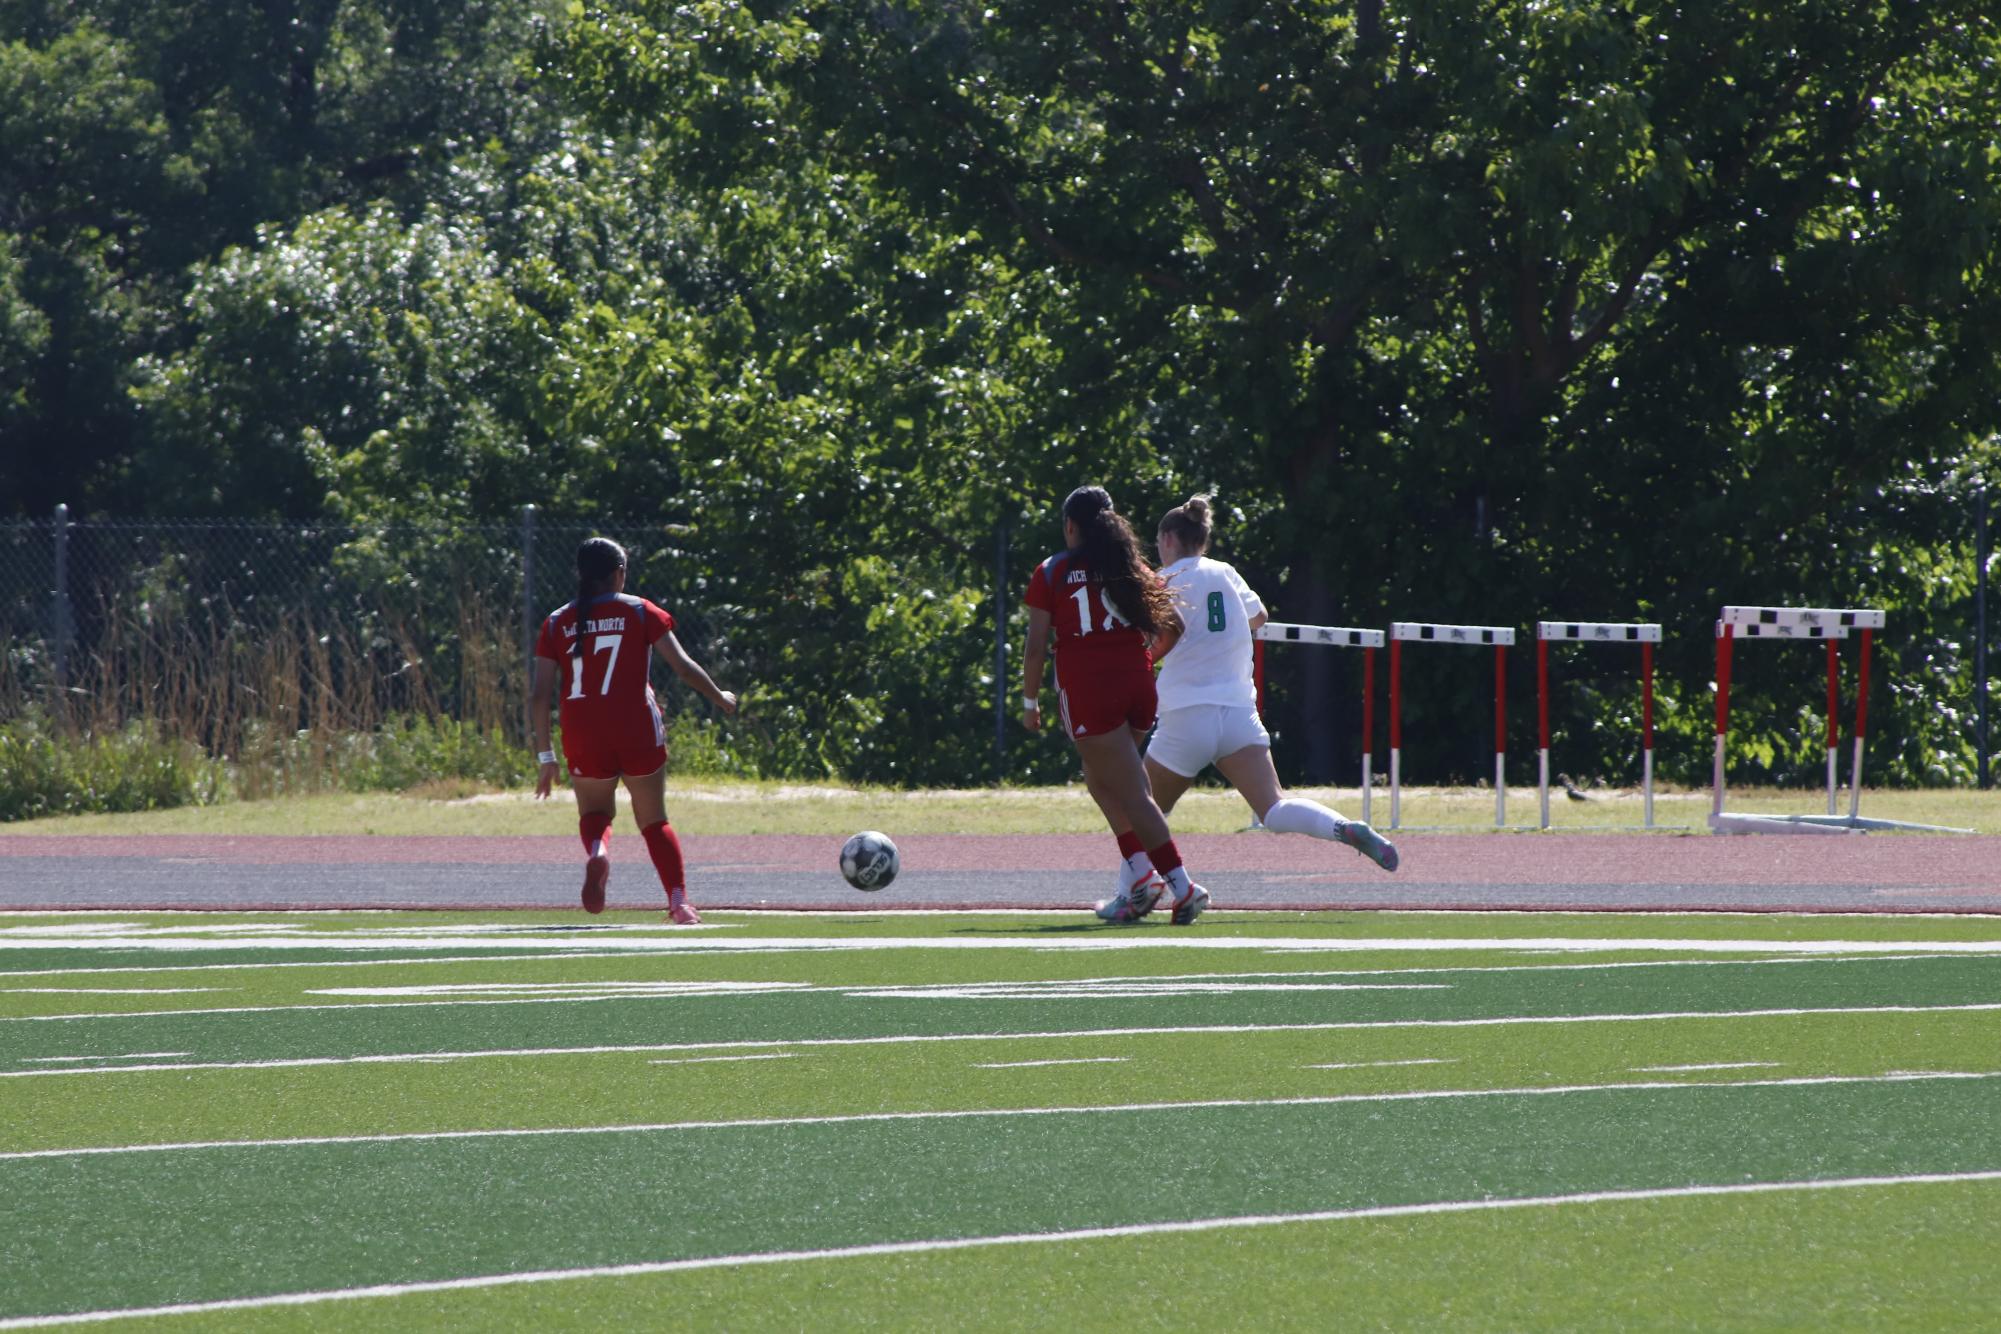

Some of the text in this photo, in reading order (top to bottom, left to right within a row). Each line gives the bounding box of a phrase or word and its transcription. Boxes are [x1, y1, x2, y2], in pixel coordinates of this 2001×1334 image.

[598, 617, 625, 632] NORTH
[1207, 591, 1226, 633] 8
[566, 634, 623, 700] 17
